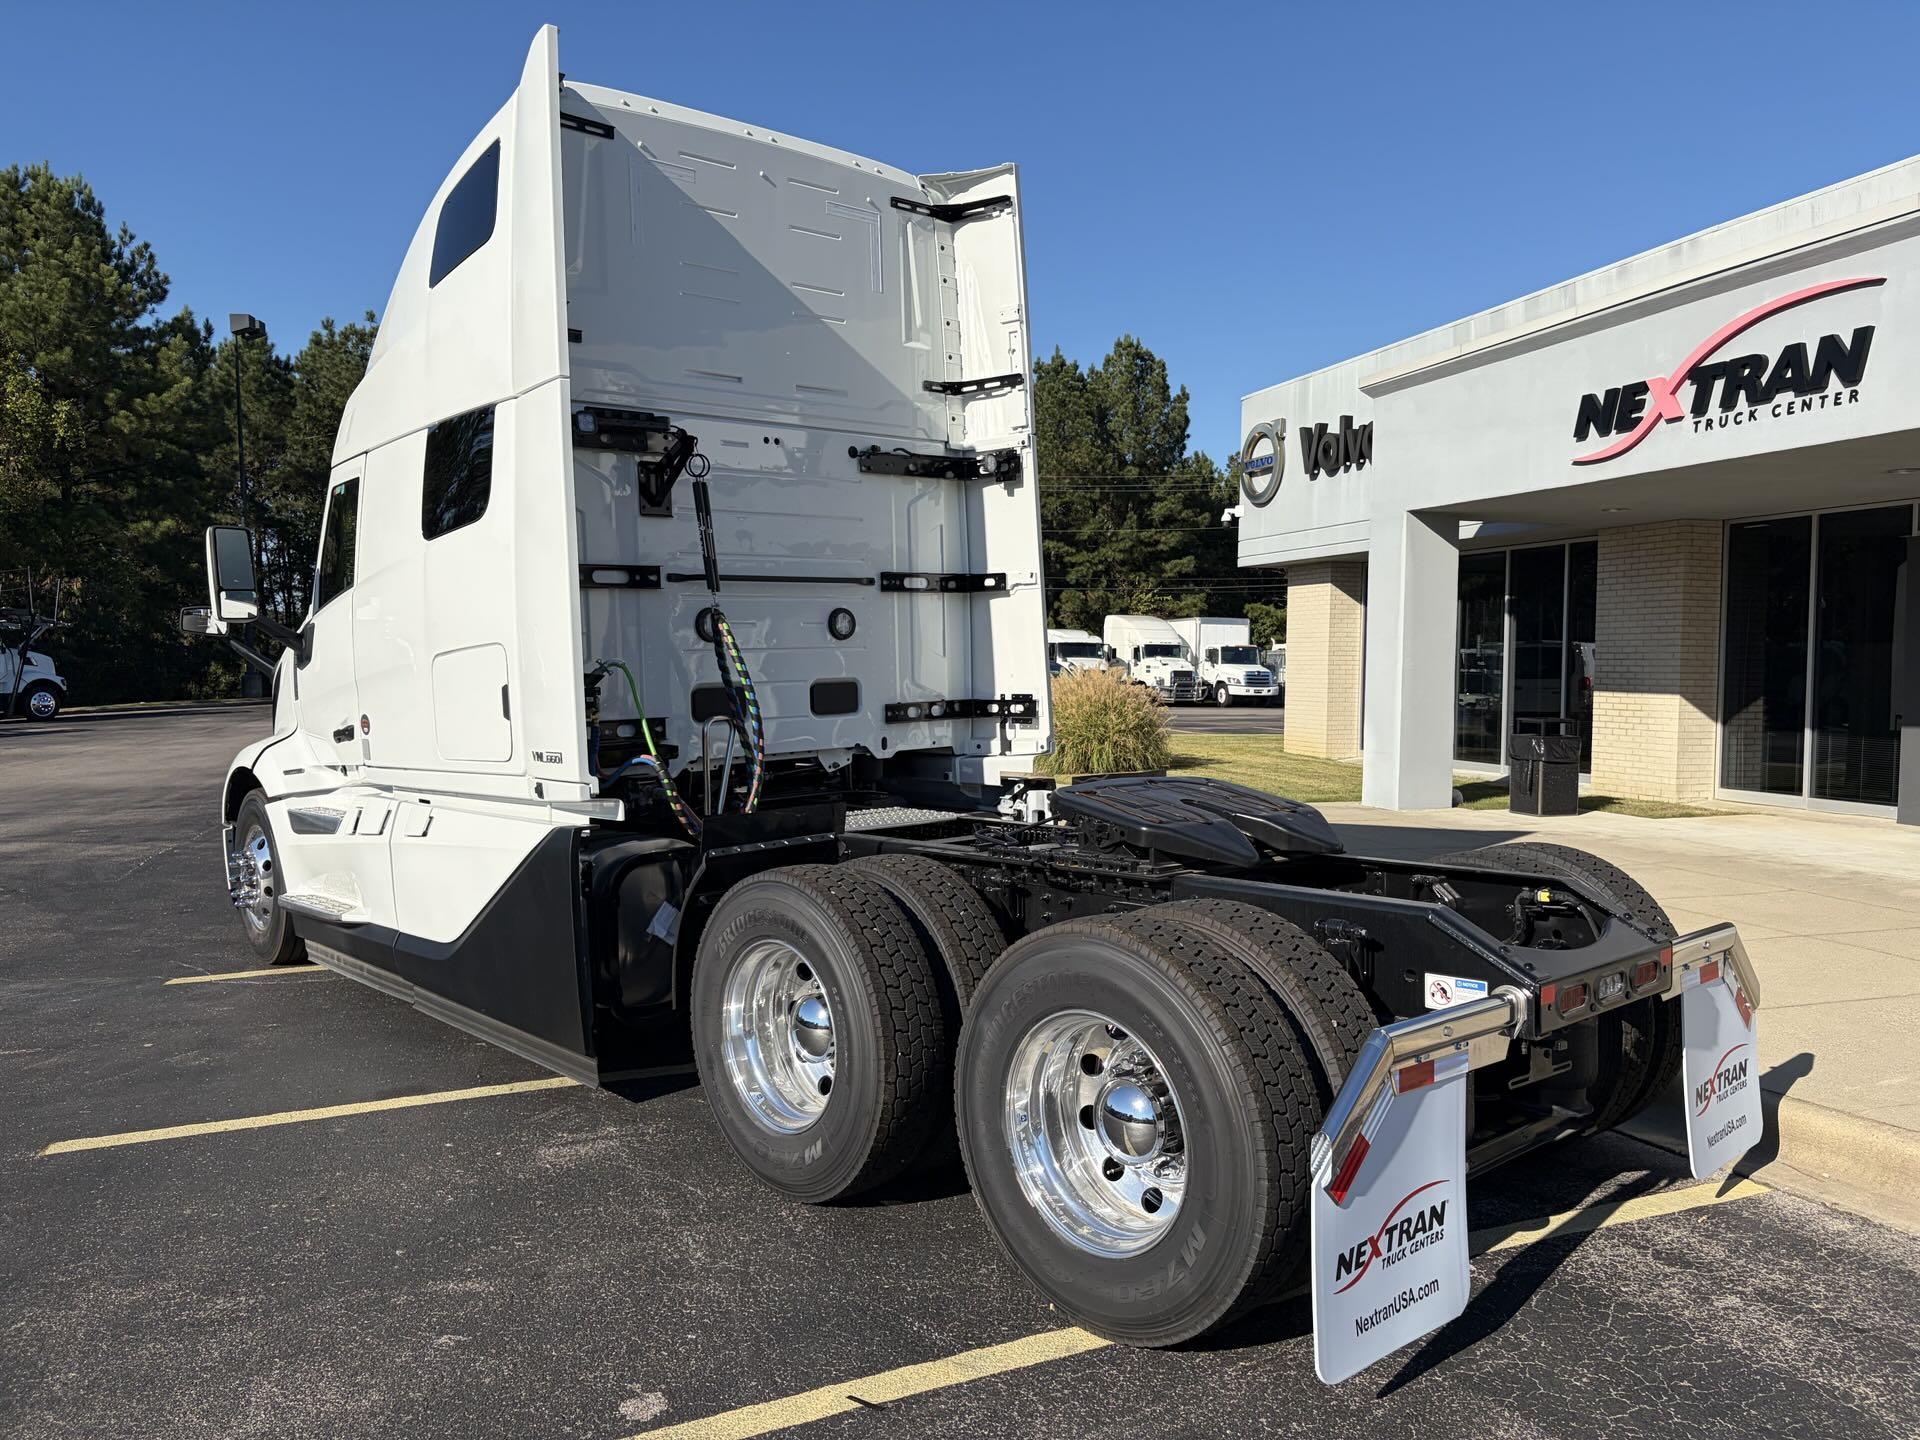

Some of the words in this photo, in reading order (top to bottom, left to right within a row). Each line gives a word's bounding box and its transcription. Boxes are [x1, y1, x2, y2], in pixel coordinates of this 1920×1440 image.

[1573, 325, 1876, 442] NEXTRAN
[1693, 407, 1759, 433] TRUCK
[1771, 389, 1861, 418] CENTER
[1244, 455, 1274, 471] VOLVO
[1694, 1059, 1748, 1108] NEXTRAN
[1716, 1091, 1729, 1104] TRUCK
[1729, 1078, 1748, 1096] CENTERS
[1706, 1114, 1747, 1149] NextranUSA.com
[1335, 1200, 1448, 1282] NEXTRAN
[1381, 1246, 1407, 1270] TRUCK
[1409, 1228, 1444, 1255] CENTERS
[1355, 1278, 1439, 1337] NextranUSA.com
